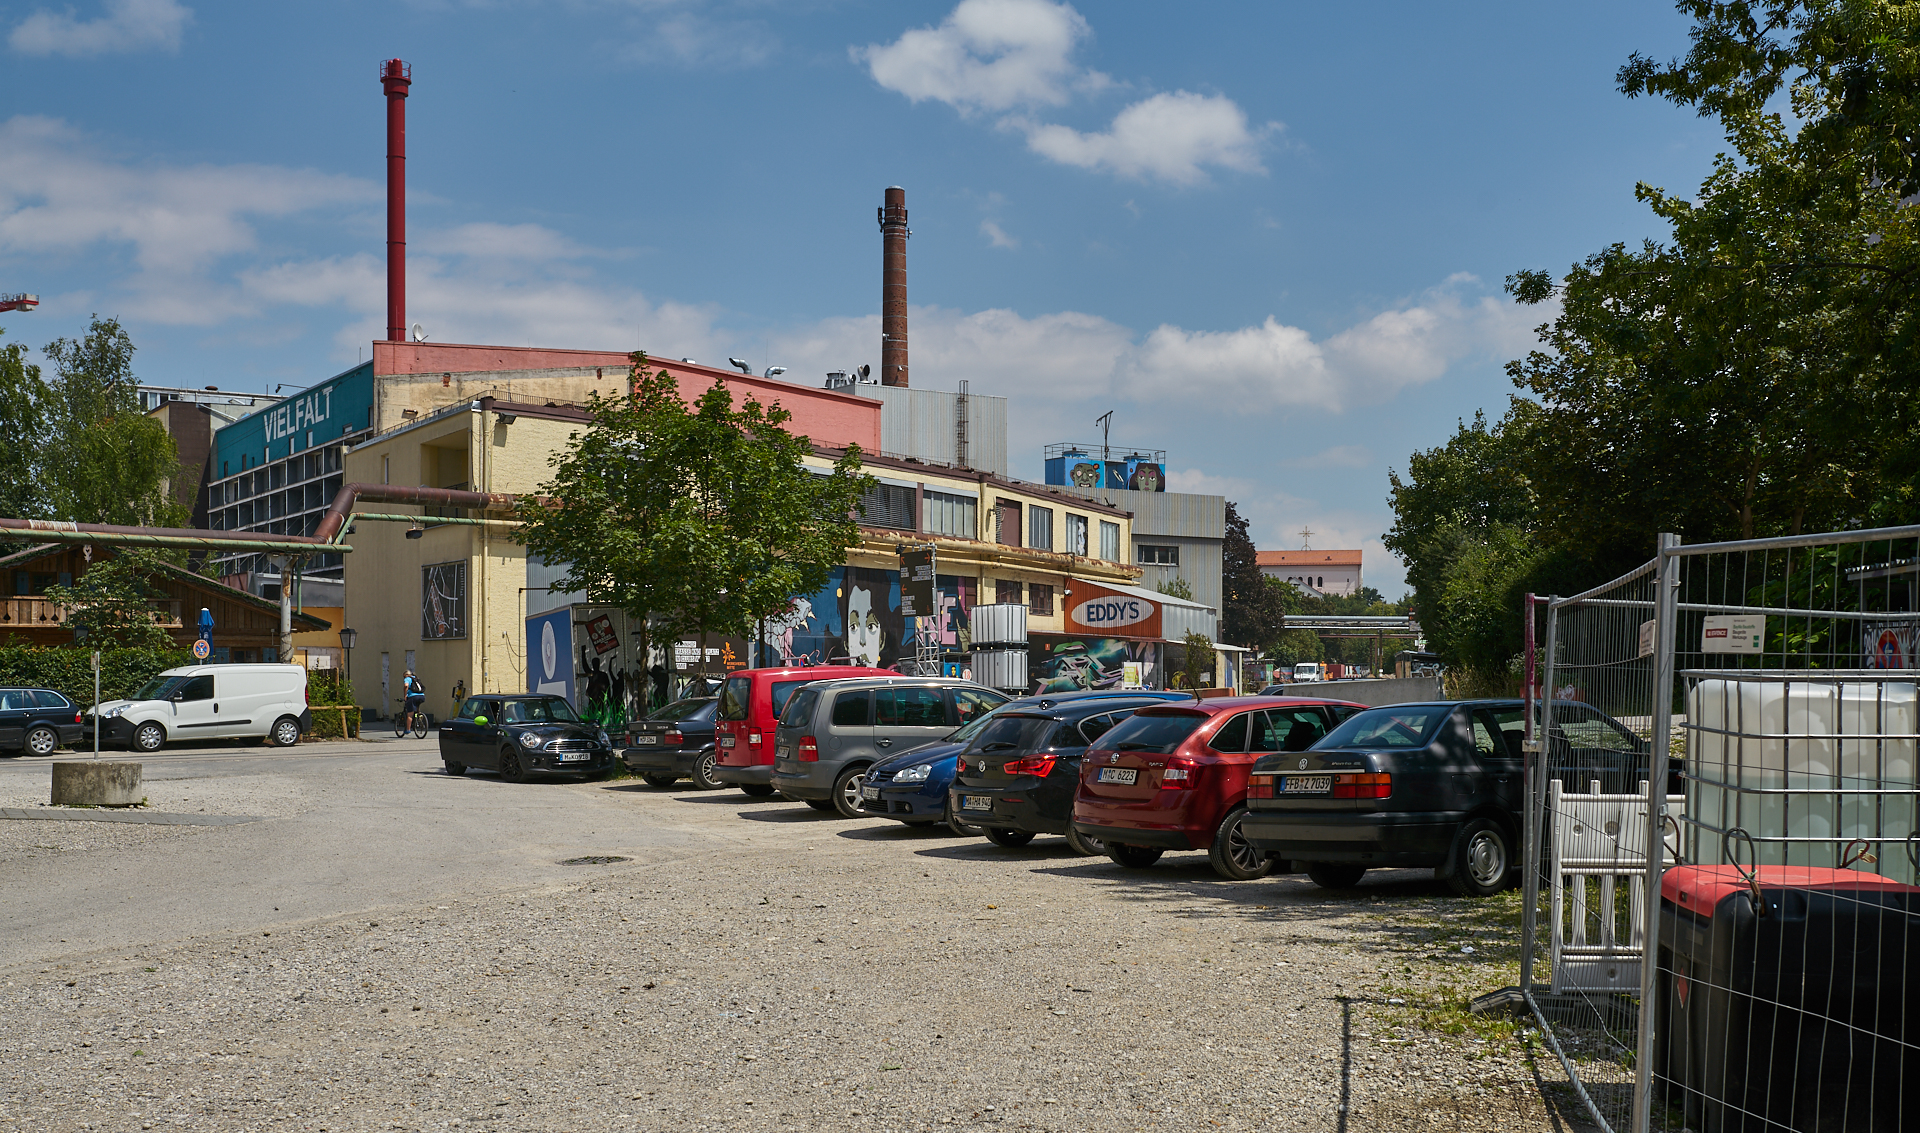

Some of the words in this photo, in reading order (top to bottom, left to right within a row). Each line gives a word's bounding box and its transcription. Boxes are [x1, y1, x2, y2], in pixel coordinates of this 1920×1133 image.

[263, 385, 333, 443] VIELFALT
[1086, 601, 1139, 622] EDDY'S
[963, 670, 971, 680] 18
[1117, 770, 1135, 781] 6223
